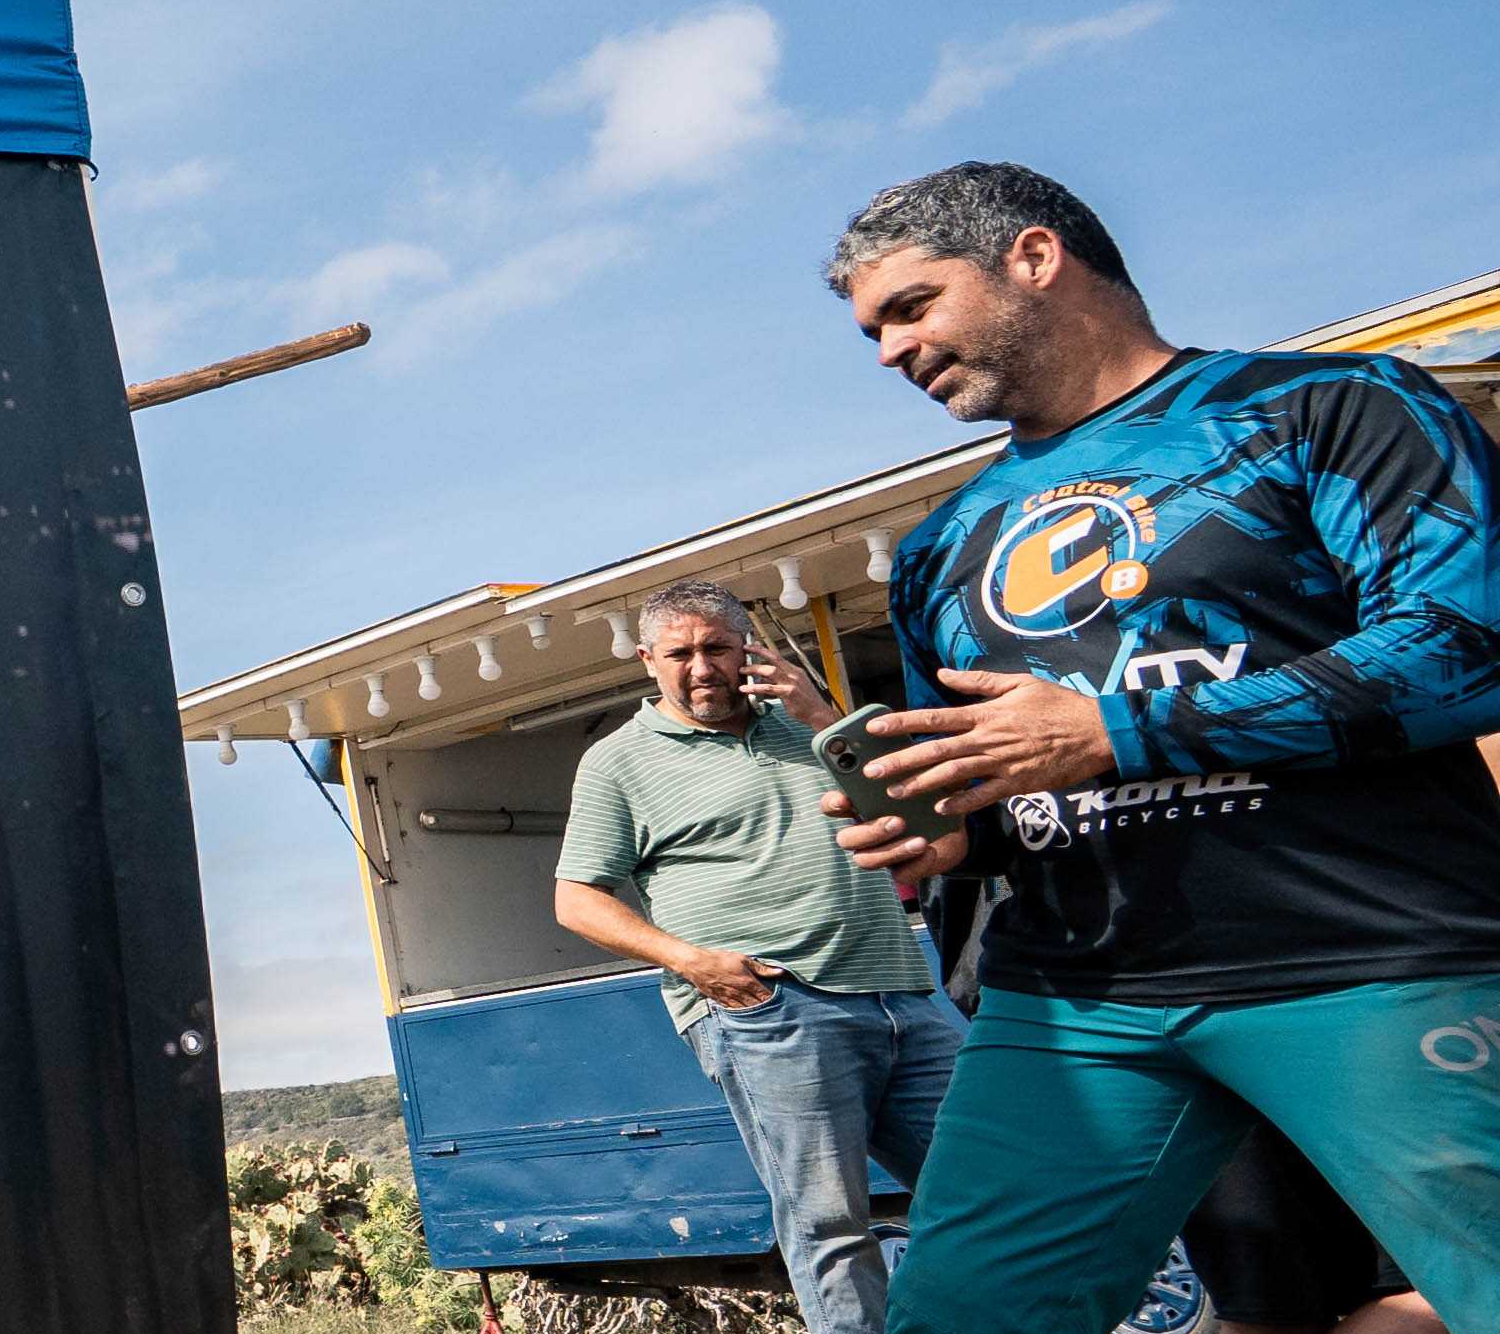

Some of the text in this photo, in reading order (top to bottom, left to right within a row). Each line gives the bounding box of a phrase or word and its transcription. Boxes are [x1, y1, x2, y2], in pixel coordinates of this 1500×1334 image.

[1022, 480, 1157, 544] Central Bike
[1058, 628, 1248, 697] VITY
[1078, 797, 1263, 835] BICYCLES
